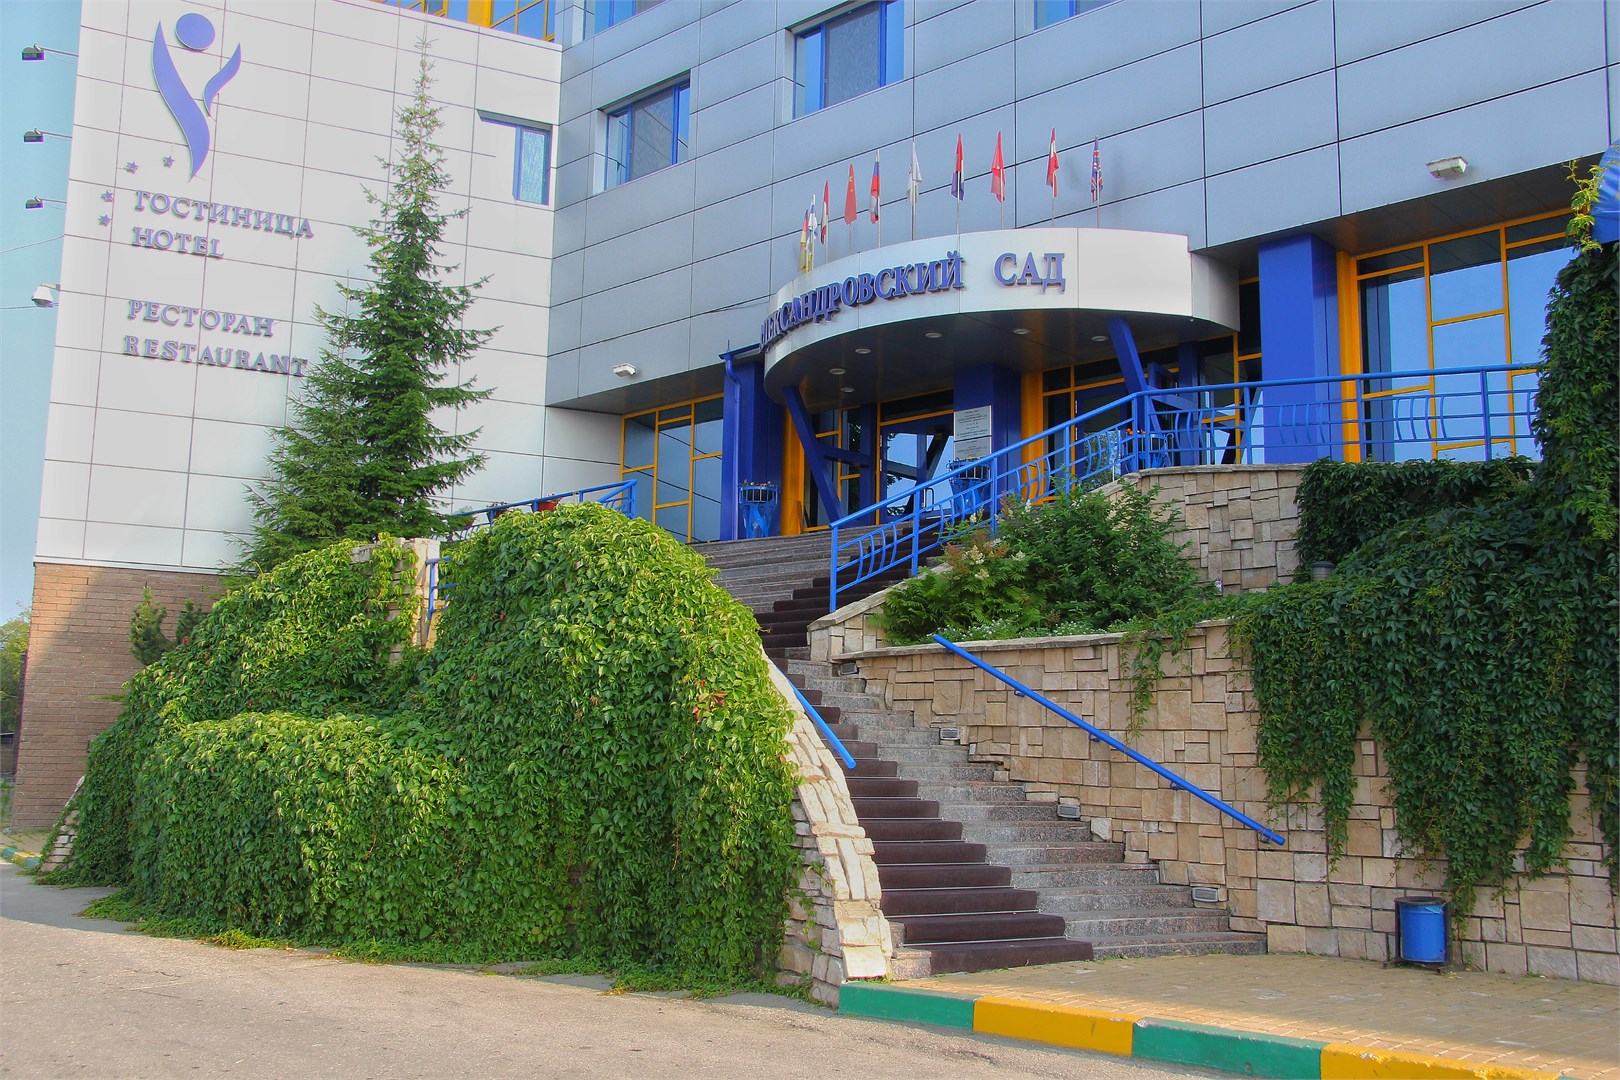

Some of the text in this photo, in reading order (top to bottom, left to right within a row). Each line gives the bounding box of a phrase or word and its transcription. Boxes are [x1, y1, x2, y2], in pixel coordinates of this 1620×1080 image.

[134, 190, 314, 239] ГОСТИНИЦА
[132, 227, 224, 258] HOTEL
[994, 252, 1066, 293] САД
[128, 300, 274, 337] РЕСТОРАН
[123, 335, 308, 377] RESTAURANT
